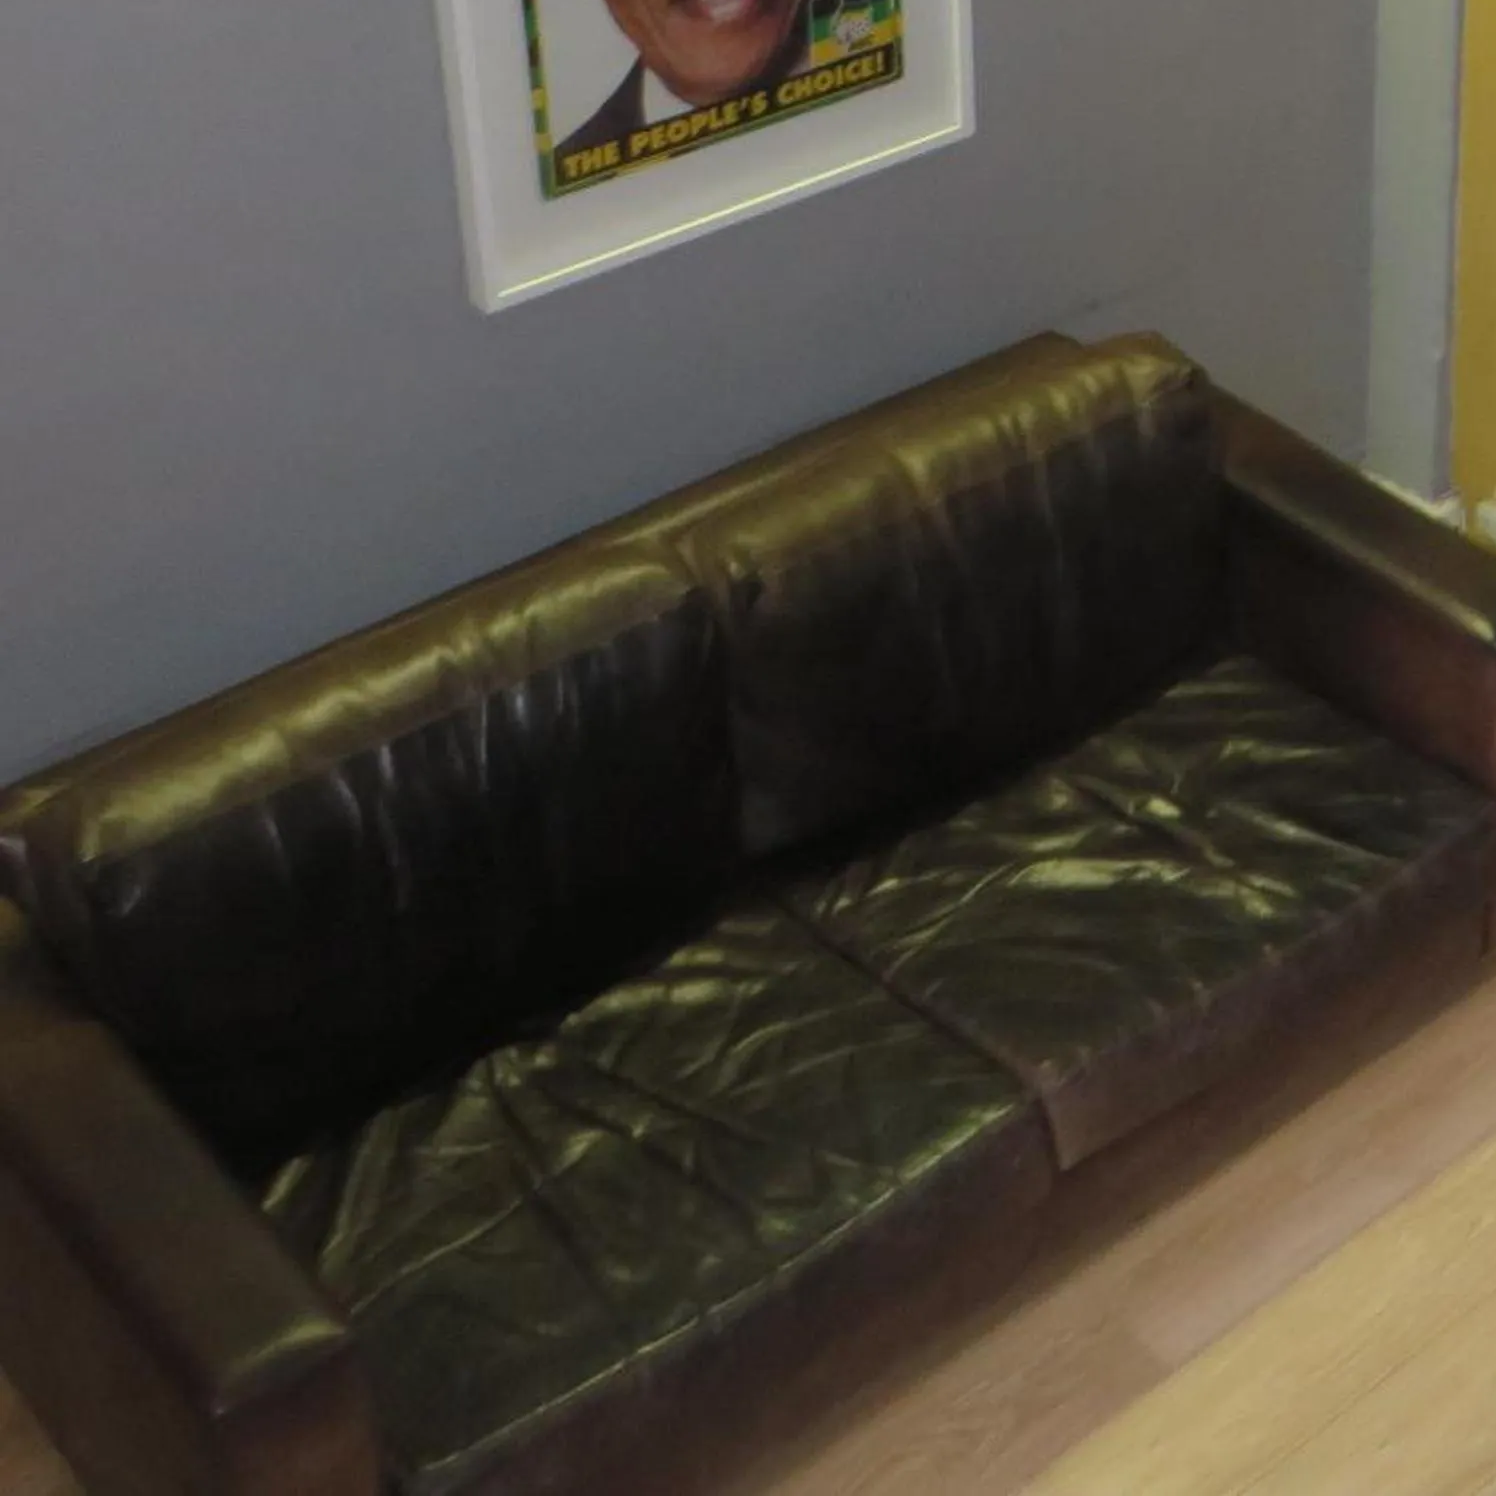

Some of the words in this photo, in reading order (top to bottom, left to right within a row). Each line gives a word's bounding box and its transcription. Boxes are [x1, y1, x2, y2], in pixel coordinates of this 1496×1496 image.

[564, 141, 621, 178] THE
[630, 90, 768, 157] PEOPLE'S
[777, 52, 885, 103] CHOICE!
